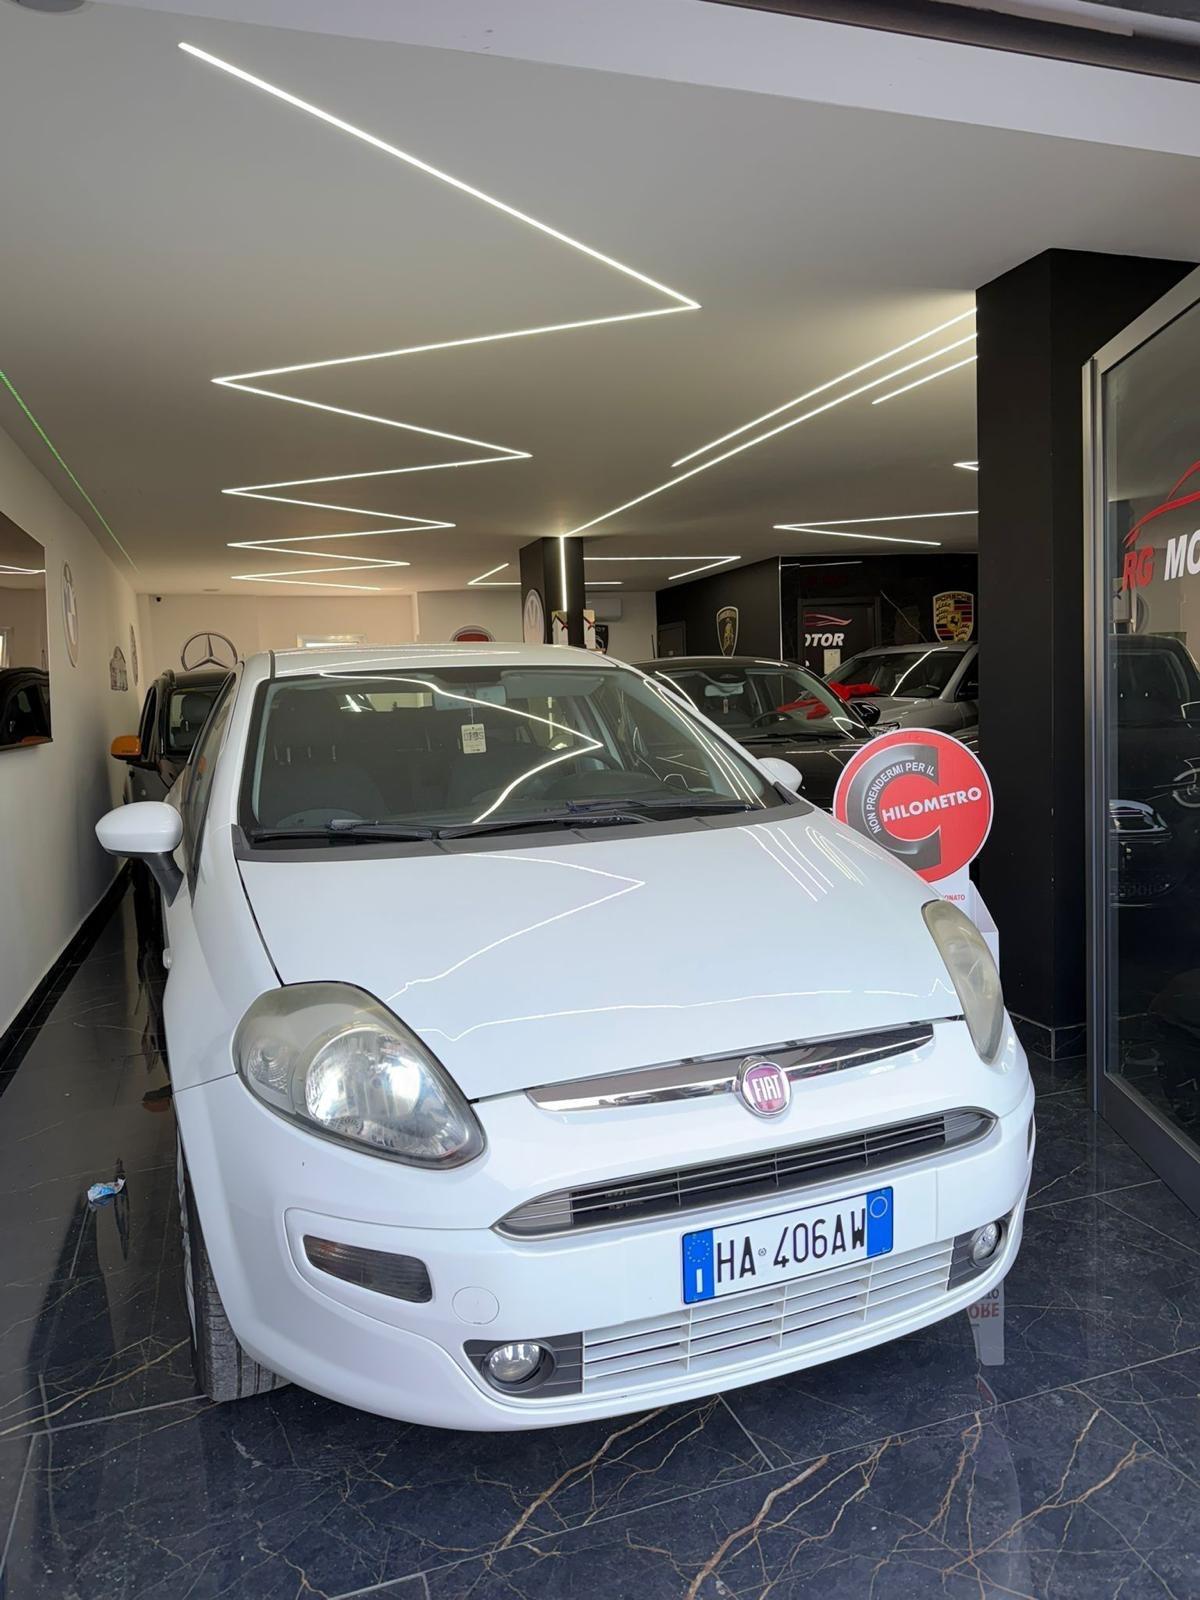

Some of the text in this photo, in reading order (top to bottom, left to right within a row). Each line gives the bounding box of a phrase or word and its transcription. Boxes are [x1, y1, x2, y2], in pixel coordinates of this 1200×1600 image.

[1122, 546, 1153, 592] RG
[866, 762, 935, 834] NON PRENDERMI PER IL
[881, 786, 982, 823] HILOMETRO
[751, 1074, 782, 1103] FIAT
[716, 1236, 756, 1283] HA
[773, 1208, 866, 1268] 406AW
